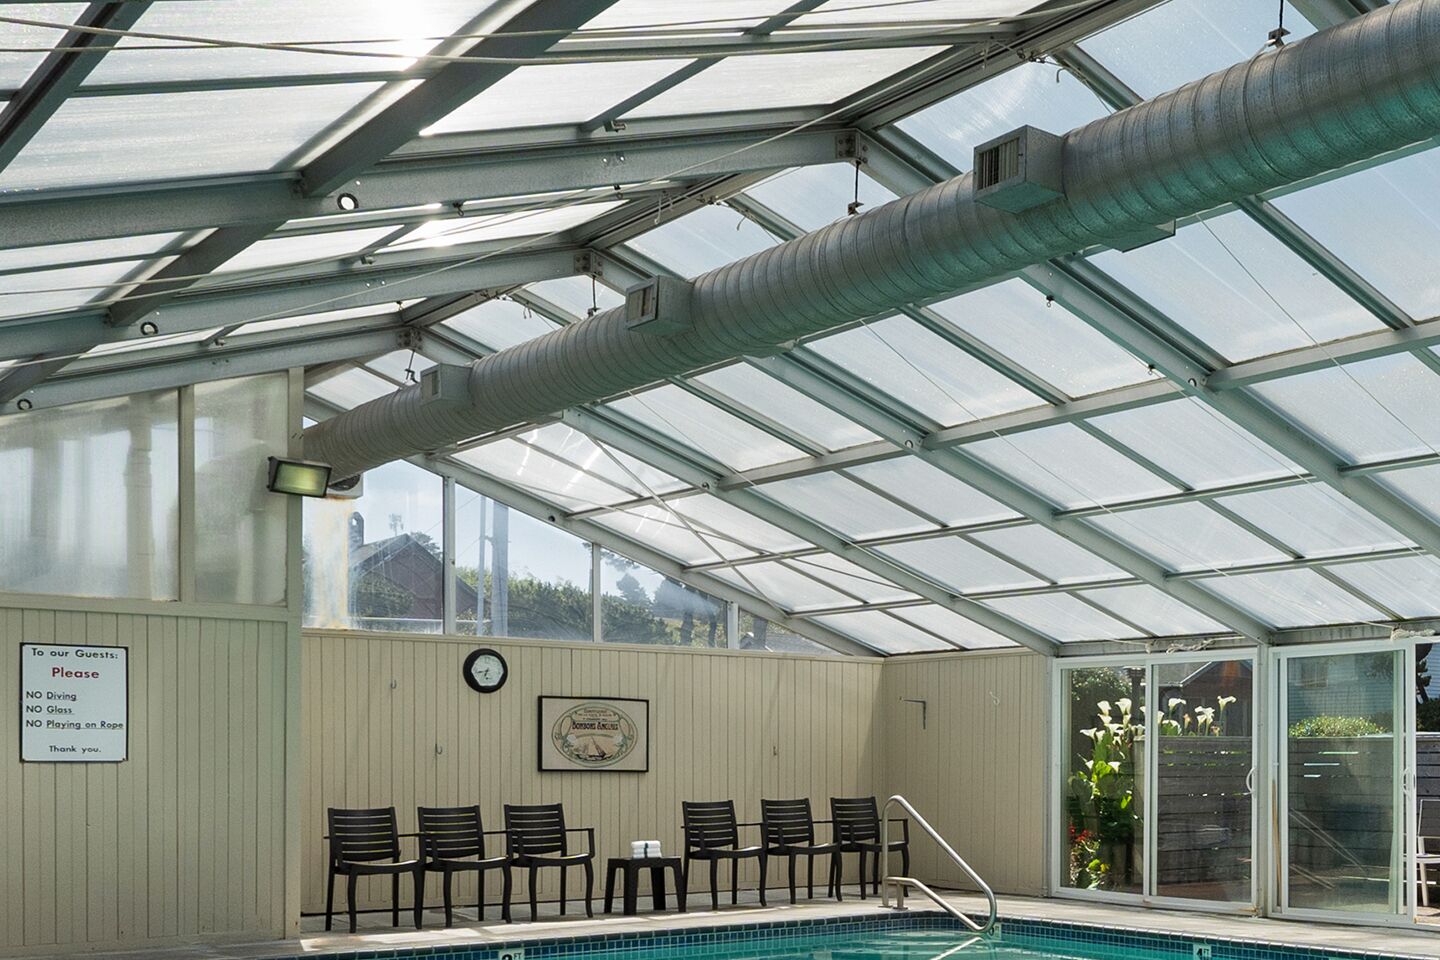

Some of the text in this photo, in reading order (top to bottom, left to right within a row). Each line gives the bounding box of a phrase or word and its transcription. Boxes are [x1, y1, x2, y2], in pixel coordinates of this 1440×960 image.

[31, 648, 44, 657] To
[75, 649, 118, 659] Guests:
[52, 667, 99, 678] Please
[26, 691, 77, 701] NO Diving
[26, 705, 72, 714] NO Glass
[46, 720, 81, 730] Playing
[100, 720, 124, 730] Rope
